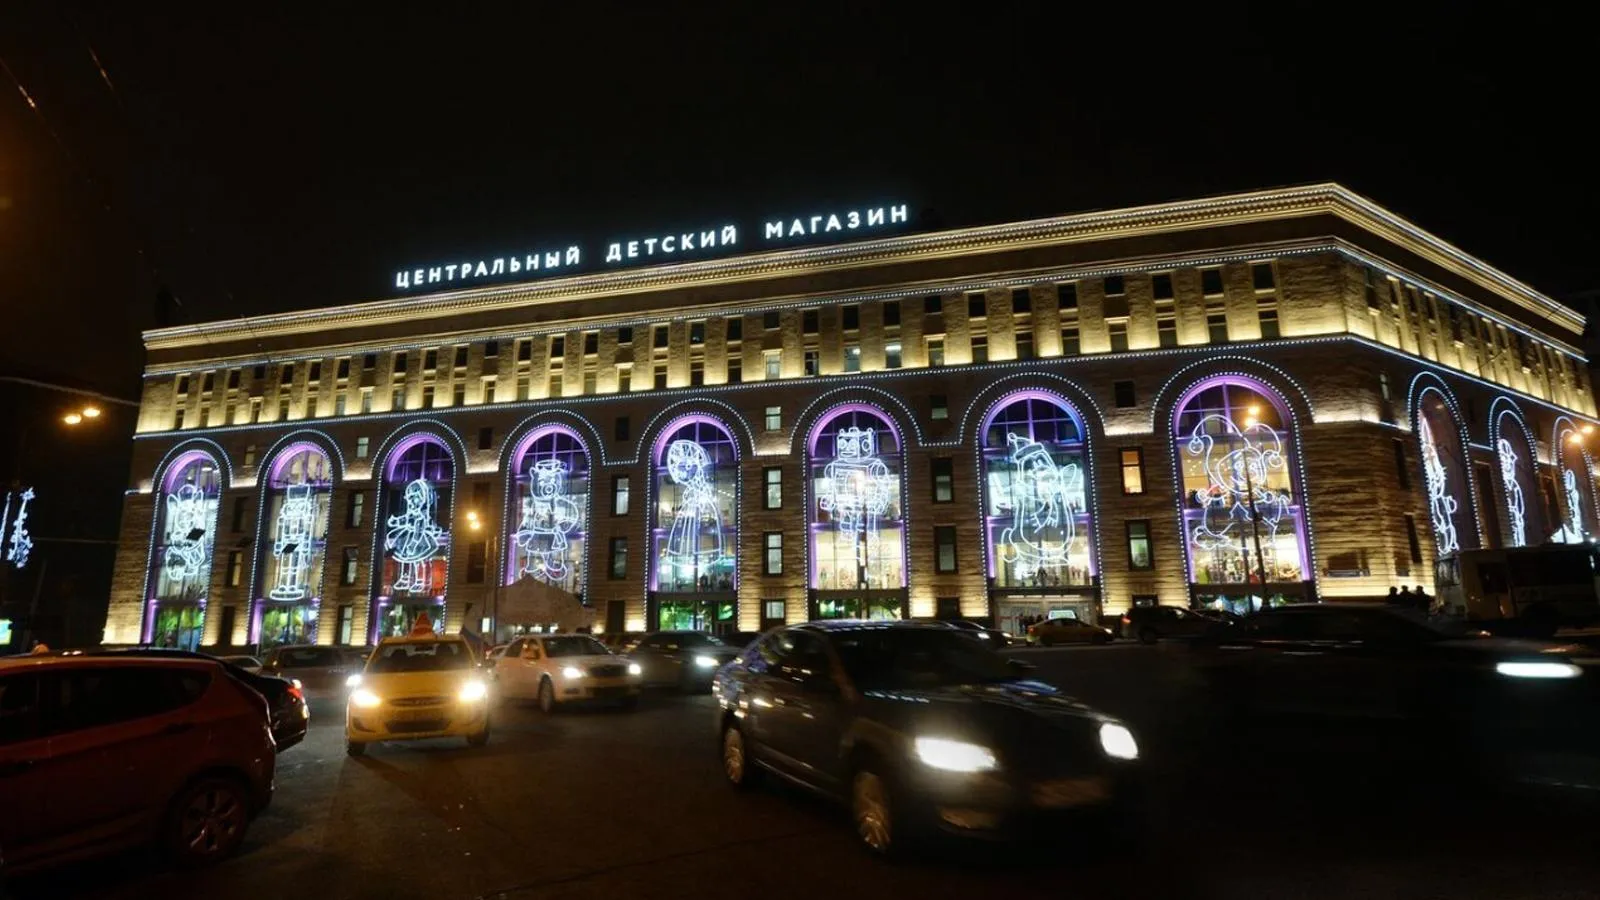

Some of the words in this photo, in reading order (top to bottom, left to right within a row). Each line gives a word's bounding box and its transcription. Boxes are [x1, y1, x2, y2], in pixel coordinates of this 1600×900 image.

[395, 245, 581, 289] ЦЕНТРАЛЬНЫЙ
[605, 224, 737, 263] ДЕТСКИЙ
[765, 204, 907, 240] МАГАЗИН
